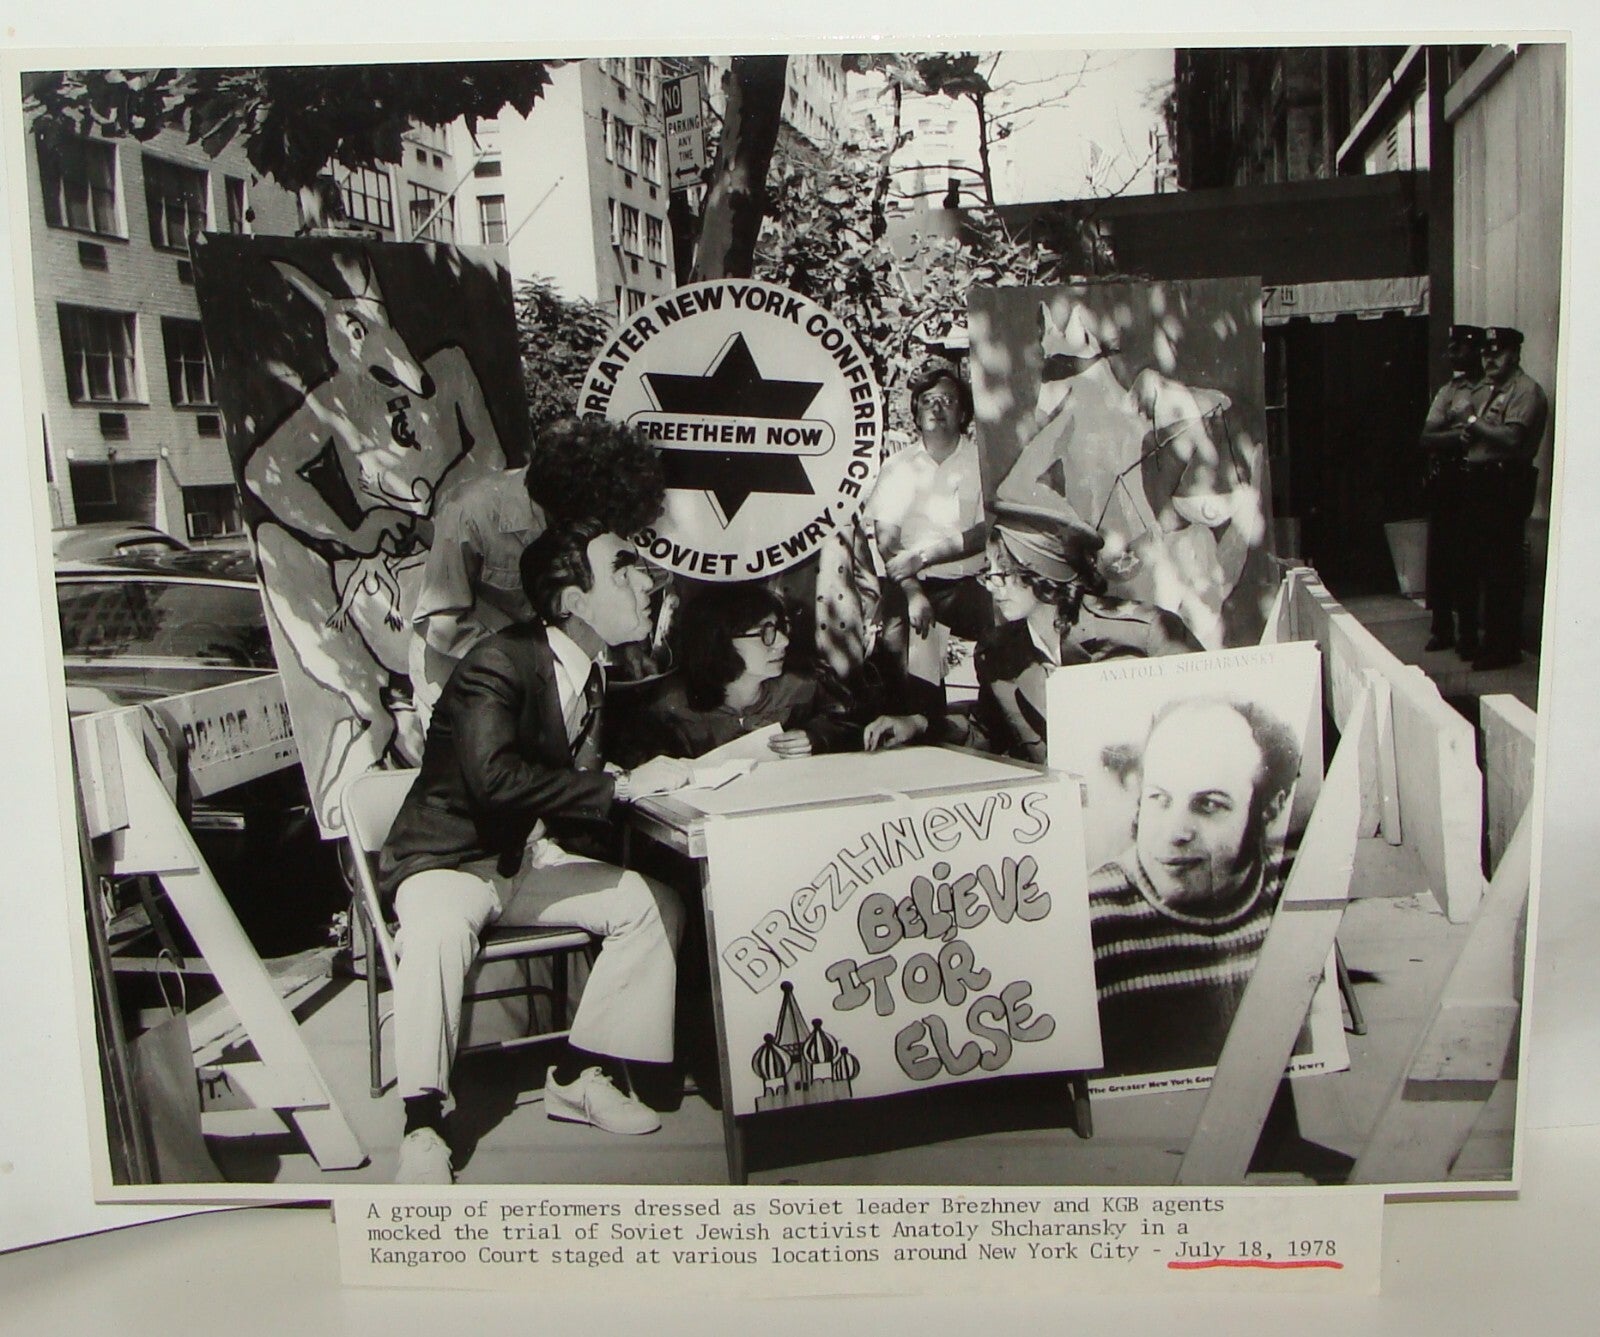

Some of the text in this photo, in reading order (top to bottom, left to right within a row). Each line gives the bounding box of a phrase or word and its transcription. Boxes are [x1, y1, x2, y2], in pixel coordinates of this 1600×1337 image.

[663, 85, 680, 112] NO
[668, 115, 700, 134] PARKING
[678, 136, 692, 147] ANY
[679, 149, 694, 160] TIME
[655, 285, 724, 327] NEW
[727, 284, 805, 325] YORK
[805, 313, 876, 499] CONFERENCE
[766, 427, 823, 447] NOW
[633, 506, 837, 576] SOVIET JEWRY
[1100, 651, 1276, 682] ANATOLY SHCHARANSKY
[894, 980, 1056, 1082] ELSE
[366, 1196, 1225, 1223] A group of performers dressed as Soviet leader Brezhnev and KGB agents
[367, 1217, 1189, 1242] mocked the trial of Soviet Jewish activist Anatoly Shcharansky in a
[369, 1247, 468, 1267] Kangaroo
[478, 1246, 540, 1264] Court
[550, 1246, 625, 1267] staged
[635, 1248, 661, 1264] at
[672, 1246, 758, 1264] various
[771, 1244, 880, 1263] locations
[893, 1243, 968, 1261] around
[978, 1243, 1017, 1261] New
[1027, 1241, 1079, 1260] York
[1089, 1242, 1140, 1262] City
[1174, 1240, 1227, 1261] July
[1238, 1240, 1273, 1261] 18,
[1288, 1239, 1337, 1257] 1978
